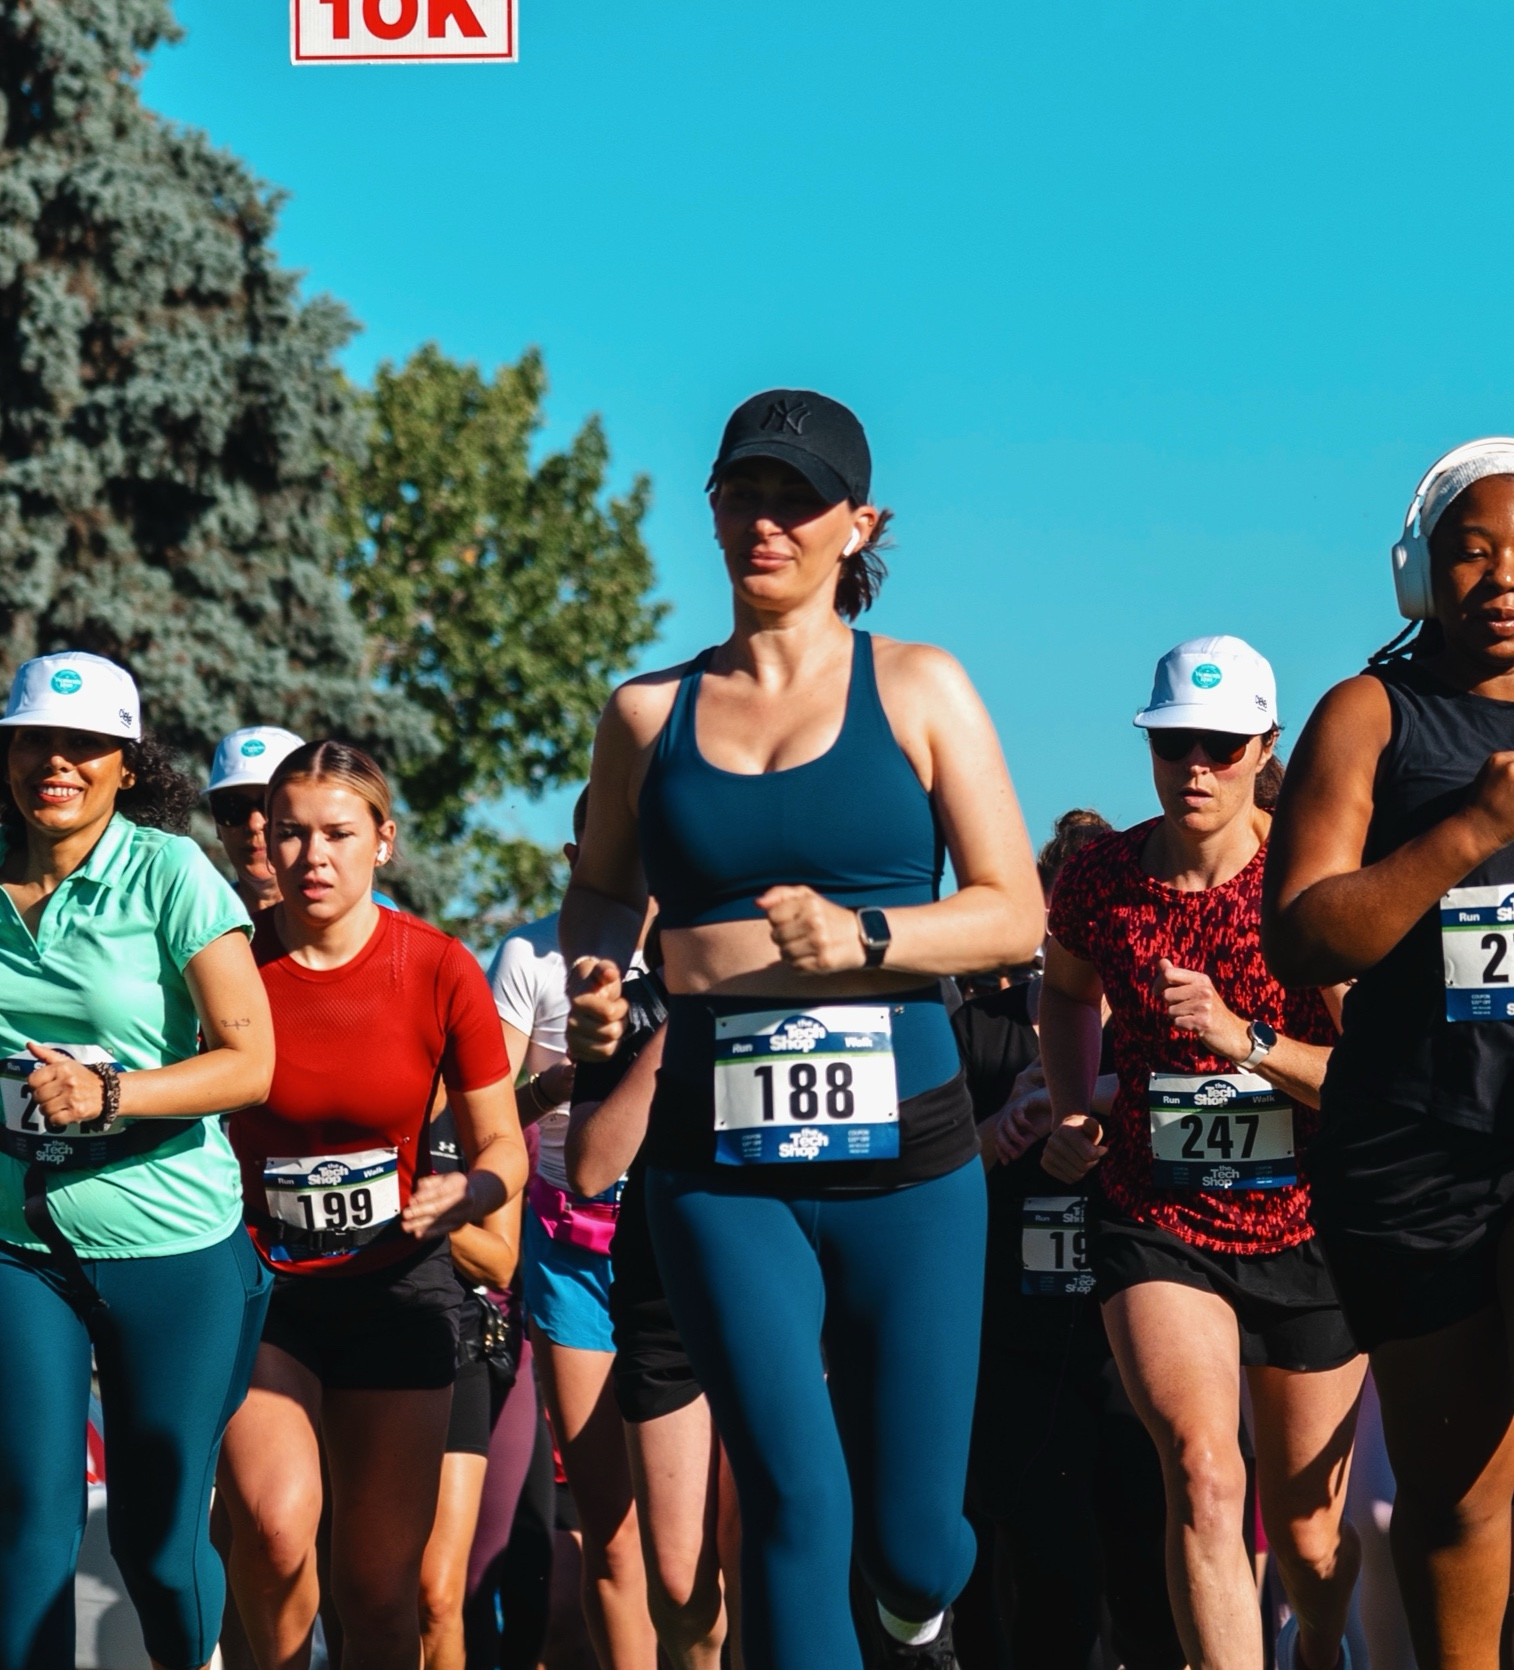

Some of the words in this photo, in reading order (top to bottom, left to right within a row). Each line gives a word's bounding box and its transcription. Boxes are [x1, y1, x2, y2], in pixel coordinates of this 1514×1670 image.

[320, 0, 487, 40] 10K
[1459, 912, 1480, 922] Run
[1481, 933, 1514, 984] 2
[784, 1023, 826, 1039] Tech
[732, 1043, 753, 1054] Run
[769, 1035, 816, 1053] Shop
[6, 1062, 20, 1071] Run
[754, 1062, 854, 1121] 188
[1205, 1086, 1236, 1098] Tech
[1163, 1096, 1180, 1104] Run
[1194, 1093, 1229, 1107] Shop
[789, 1132, 829, 1146] Tech
[1180, 1114, 1259, 1159] 247
[43, 1143, 73, 1155] Tech
[779, 1143, 819, 1160] Shop
[36, 1150, 65, 1165] Shop
[318, 1165, 349, 1176] Tech
[363, 1167, 384, 1178] Walk
[1210, 1168, 1239, 1179] Tech
[307, 1174, 342, 1186] Shop
[1202, 1176, 1233, 1189] Shop
[297, 1188, 373, 1232] 199
